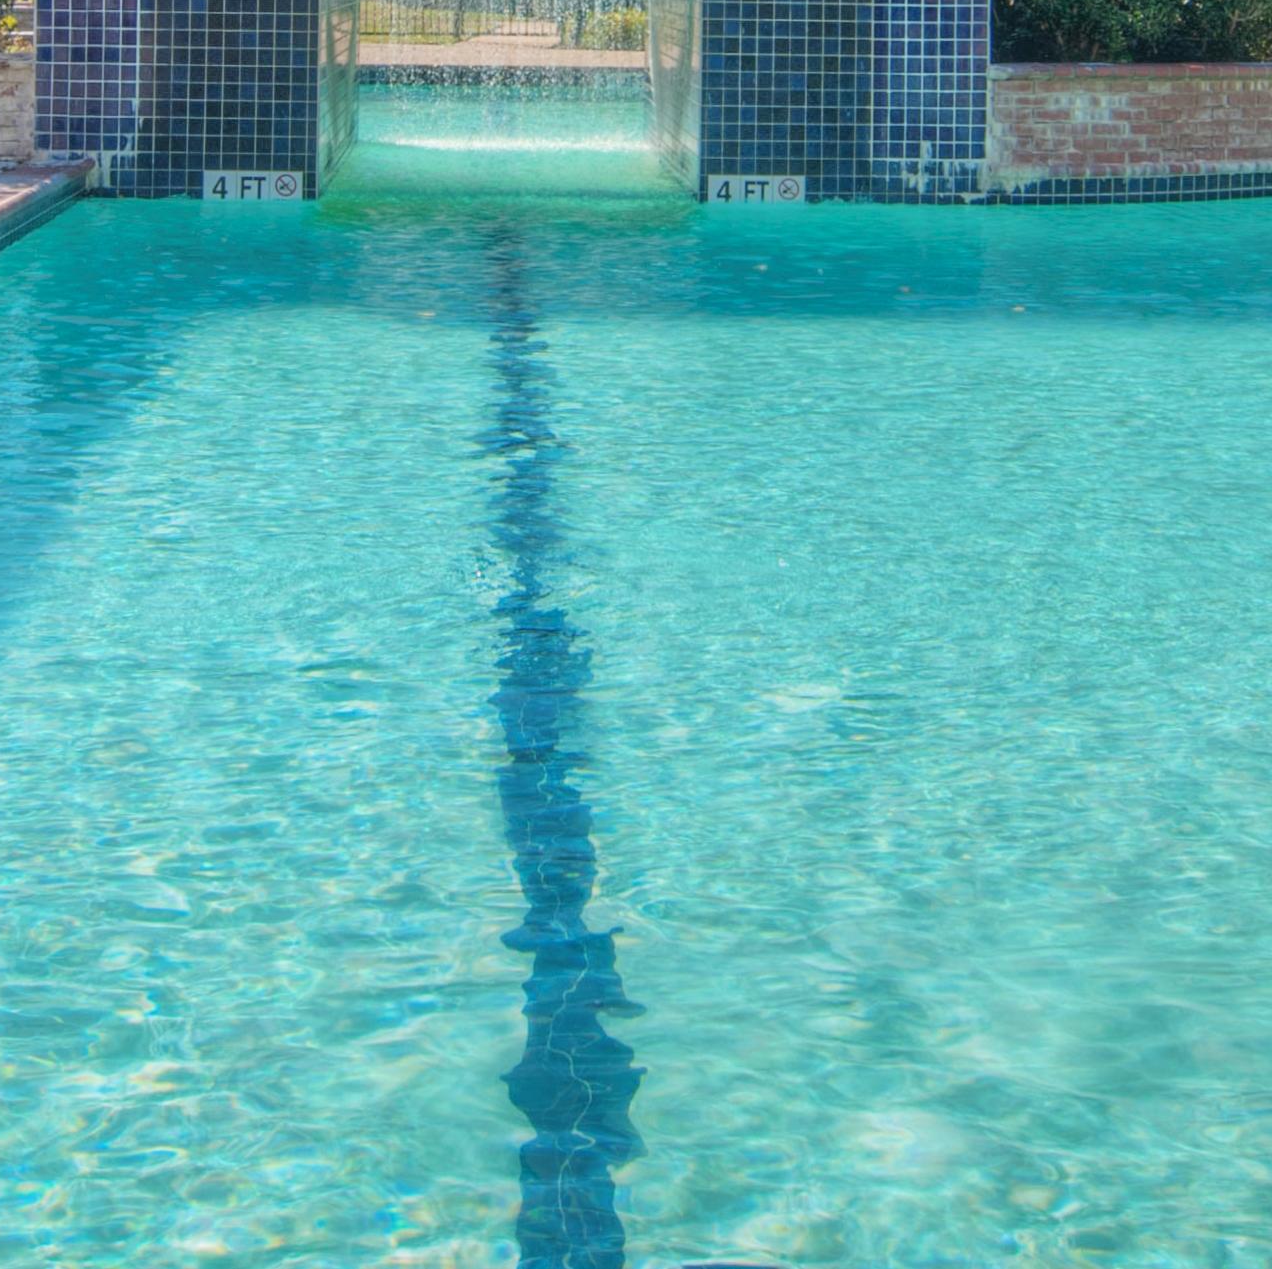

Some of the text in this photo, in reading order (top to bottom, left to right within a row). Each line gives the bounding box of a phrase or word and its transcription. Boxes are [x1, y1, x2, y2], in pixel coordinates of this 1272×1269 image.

[212, 175, 267, 200] 4 FT
[716, 179, 770, 203] 4 FT
